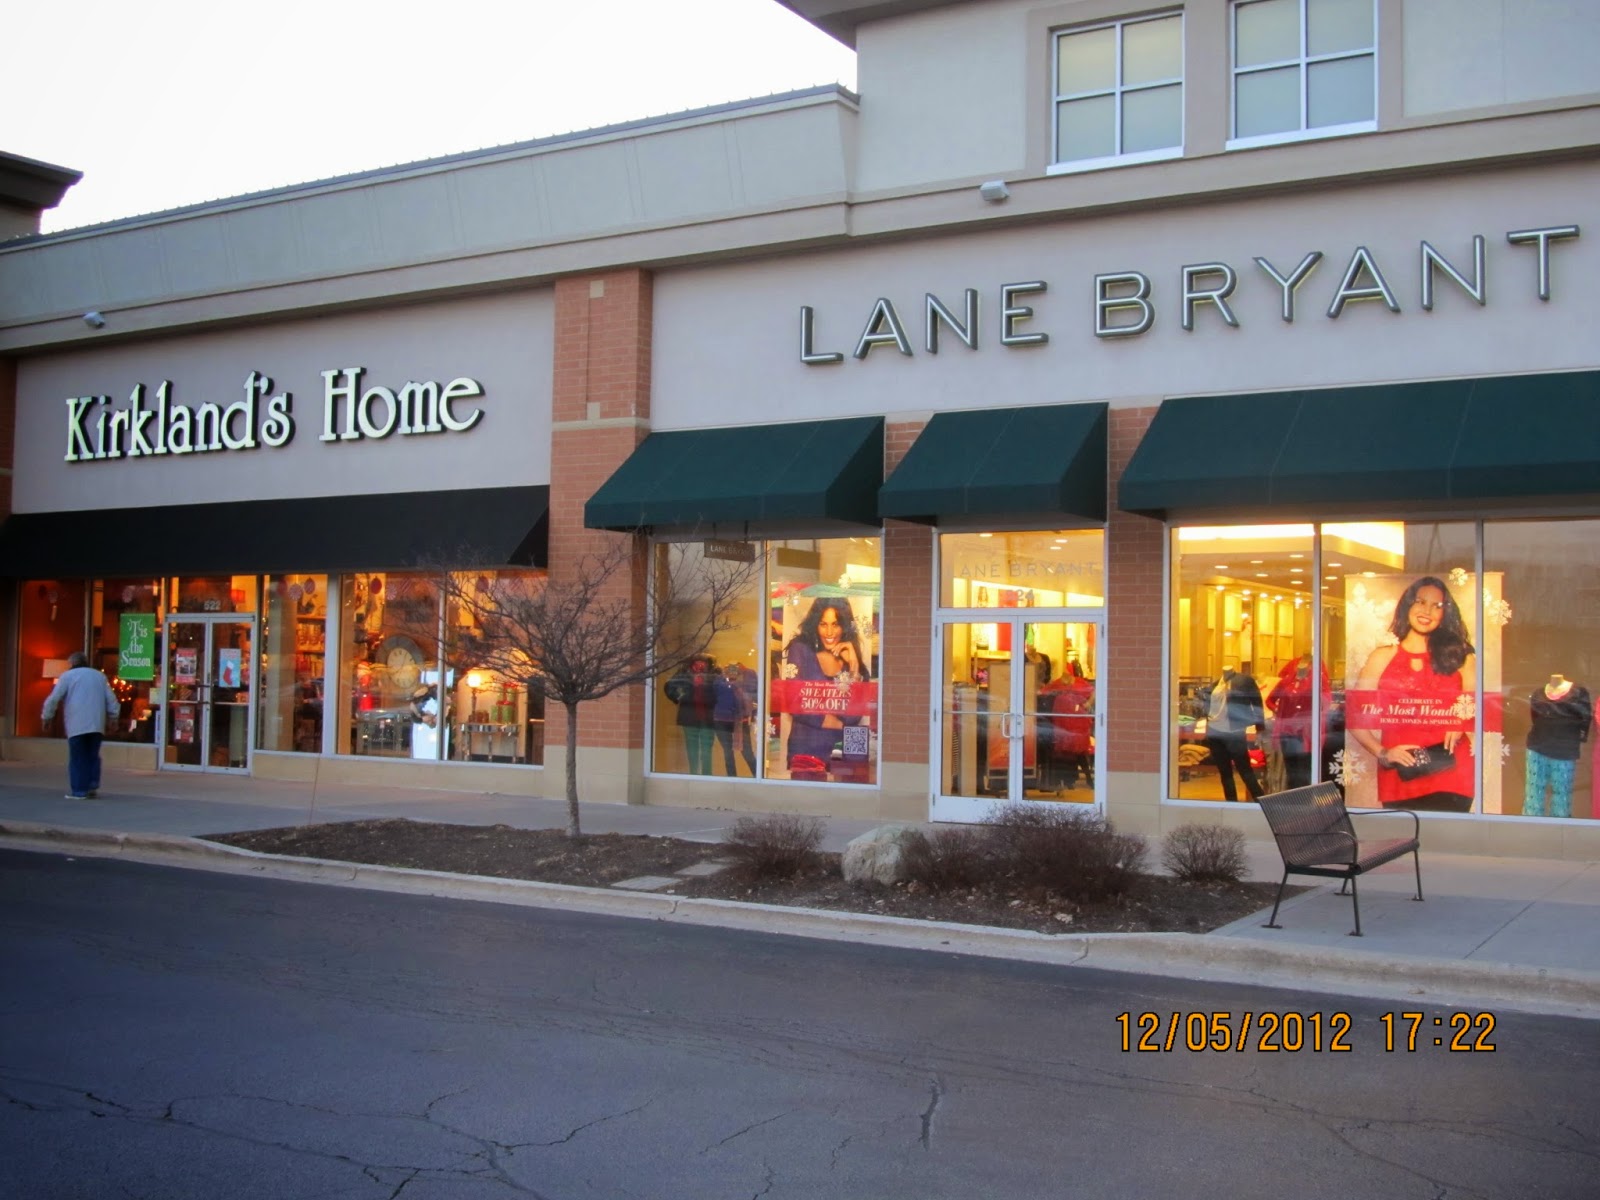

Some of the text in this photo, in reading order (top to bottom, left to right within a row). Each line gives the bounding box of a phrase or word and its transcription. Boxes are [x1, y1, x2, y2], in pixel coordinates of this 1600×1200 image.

[800, 224, 1581, 365] LANE BRYANT
[64, 366, 486, 463] Kirkland's Home
[949, 563, 1000, 578] ANE
[129, 637, 144, 654] the
[120, 648, 151, 671] Season
[801, 697, 849, 710] 50% OFF
[1361, 703, 1383, 715] The
[1387, 704, 1416, 716] Most
